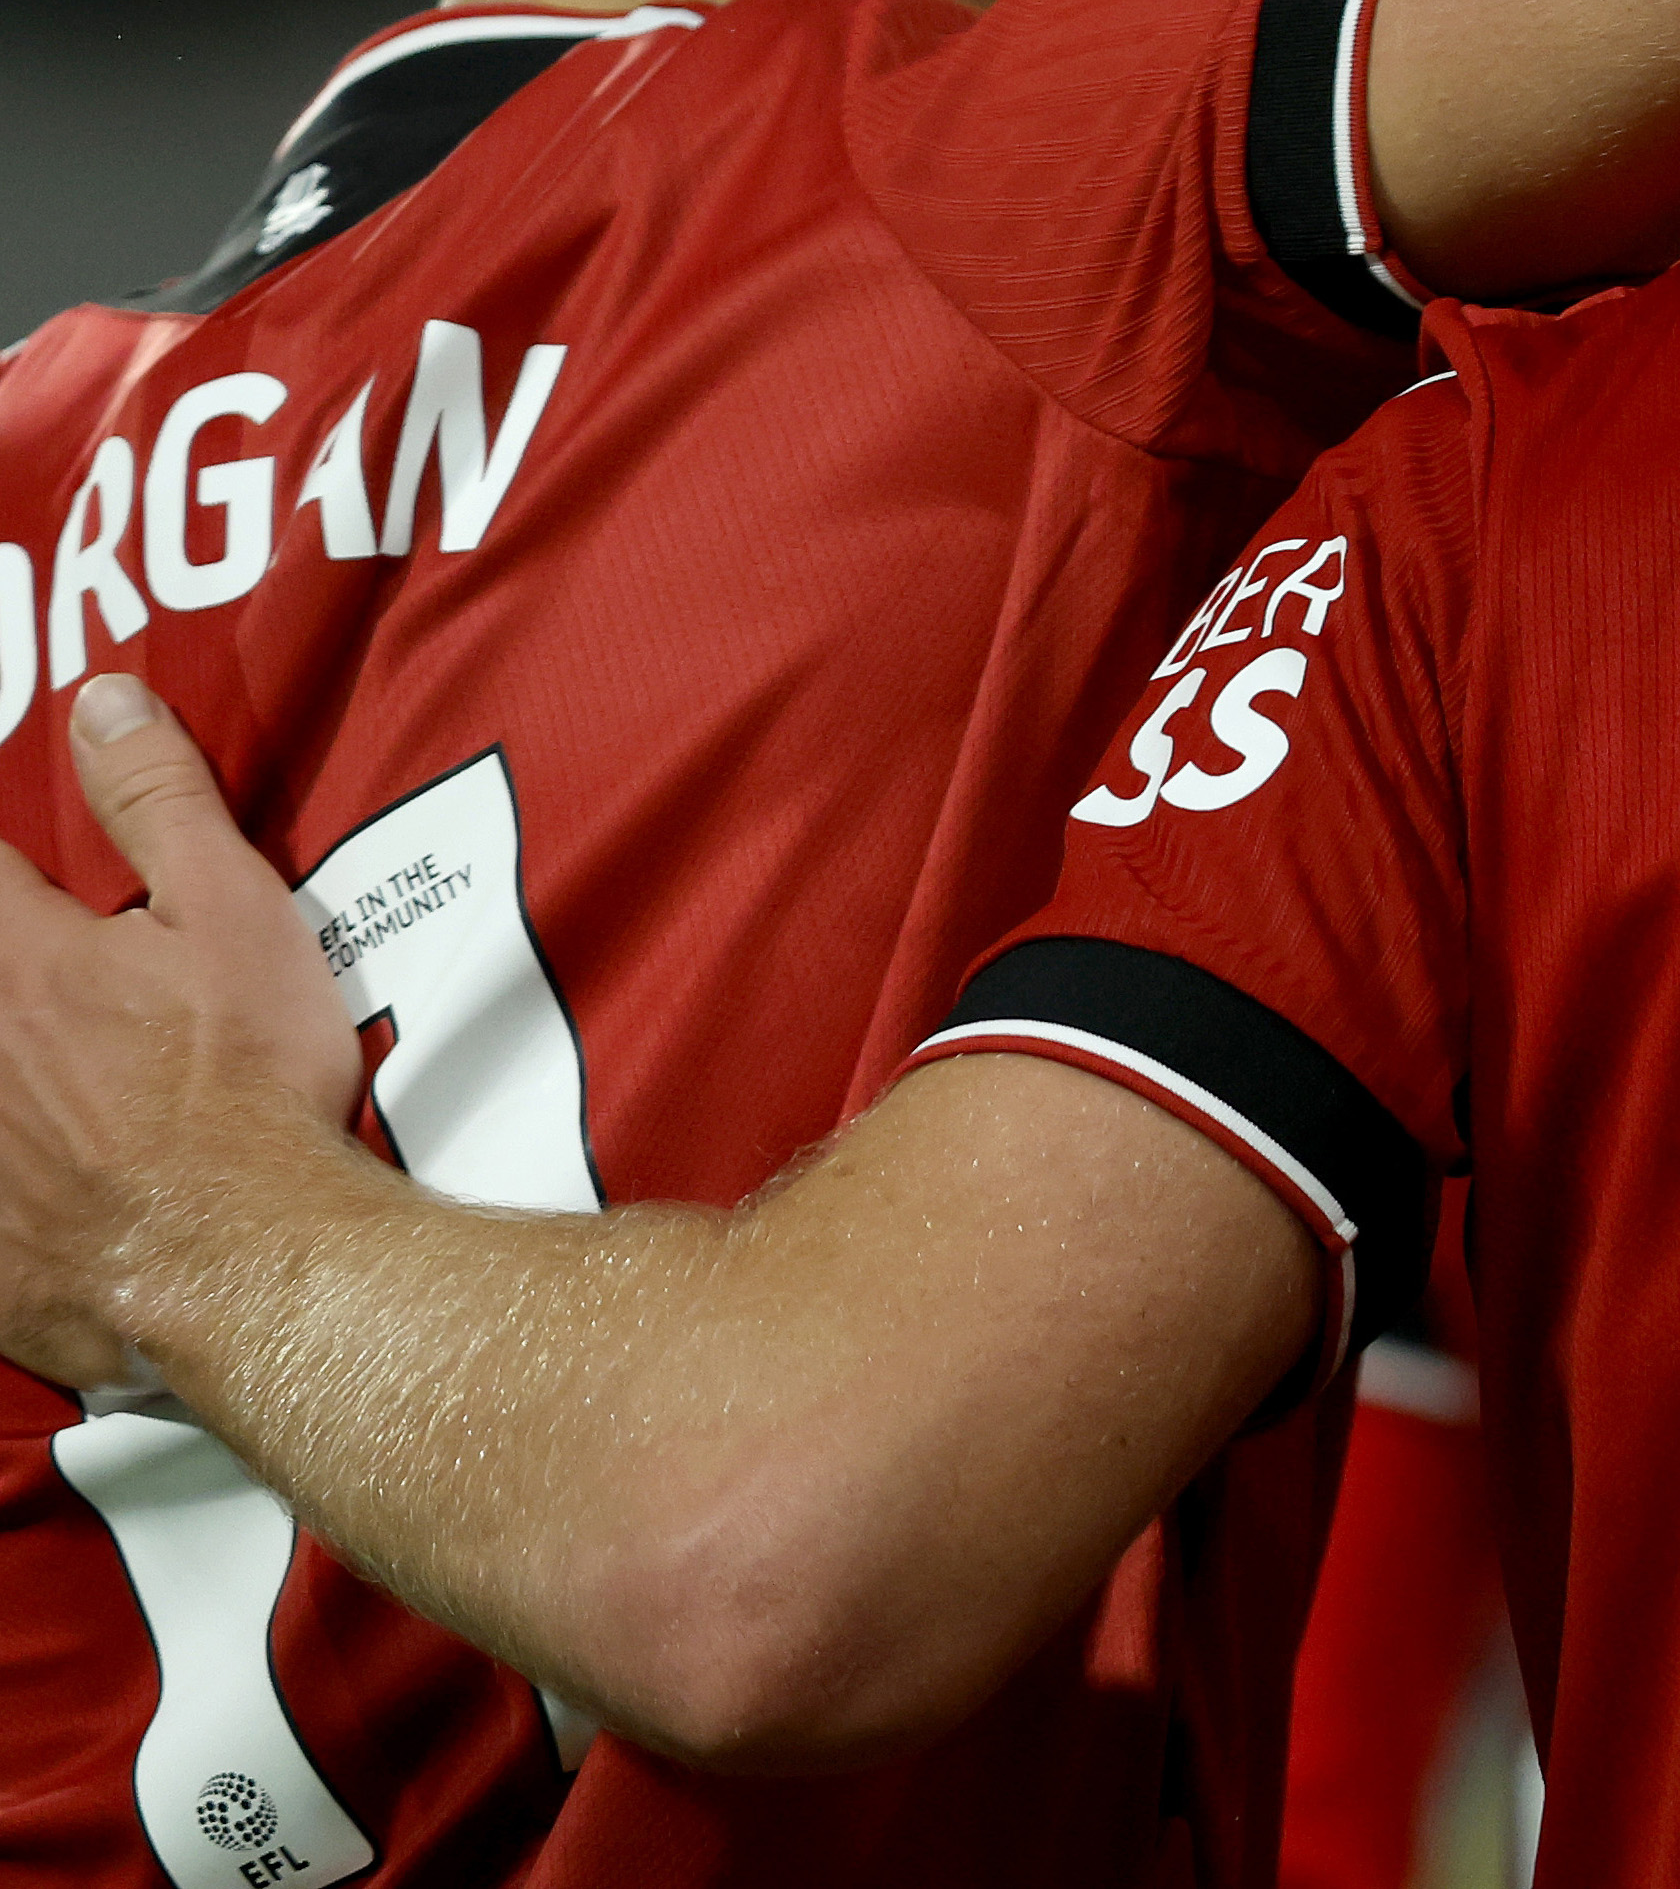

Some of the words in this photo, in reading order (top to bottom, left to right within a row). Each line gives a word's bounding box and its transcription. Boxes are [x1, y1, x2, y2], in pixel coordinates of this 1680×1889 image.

[318, 910, 356, 953] EFL
[355, 885, 387, 922] IN
[387, 853, 441, 898] THE
[328, 862, 472, 978] COMMUNITY
[239, 1845, 310, 1889] EFL
